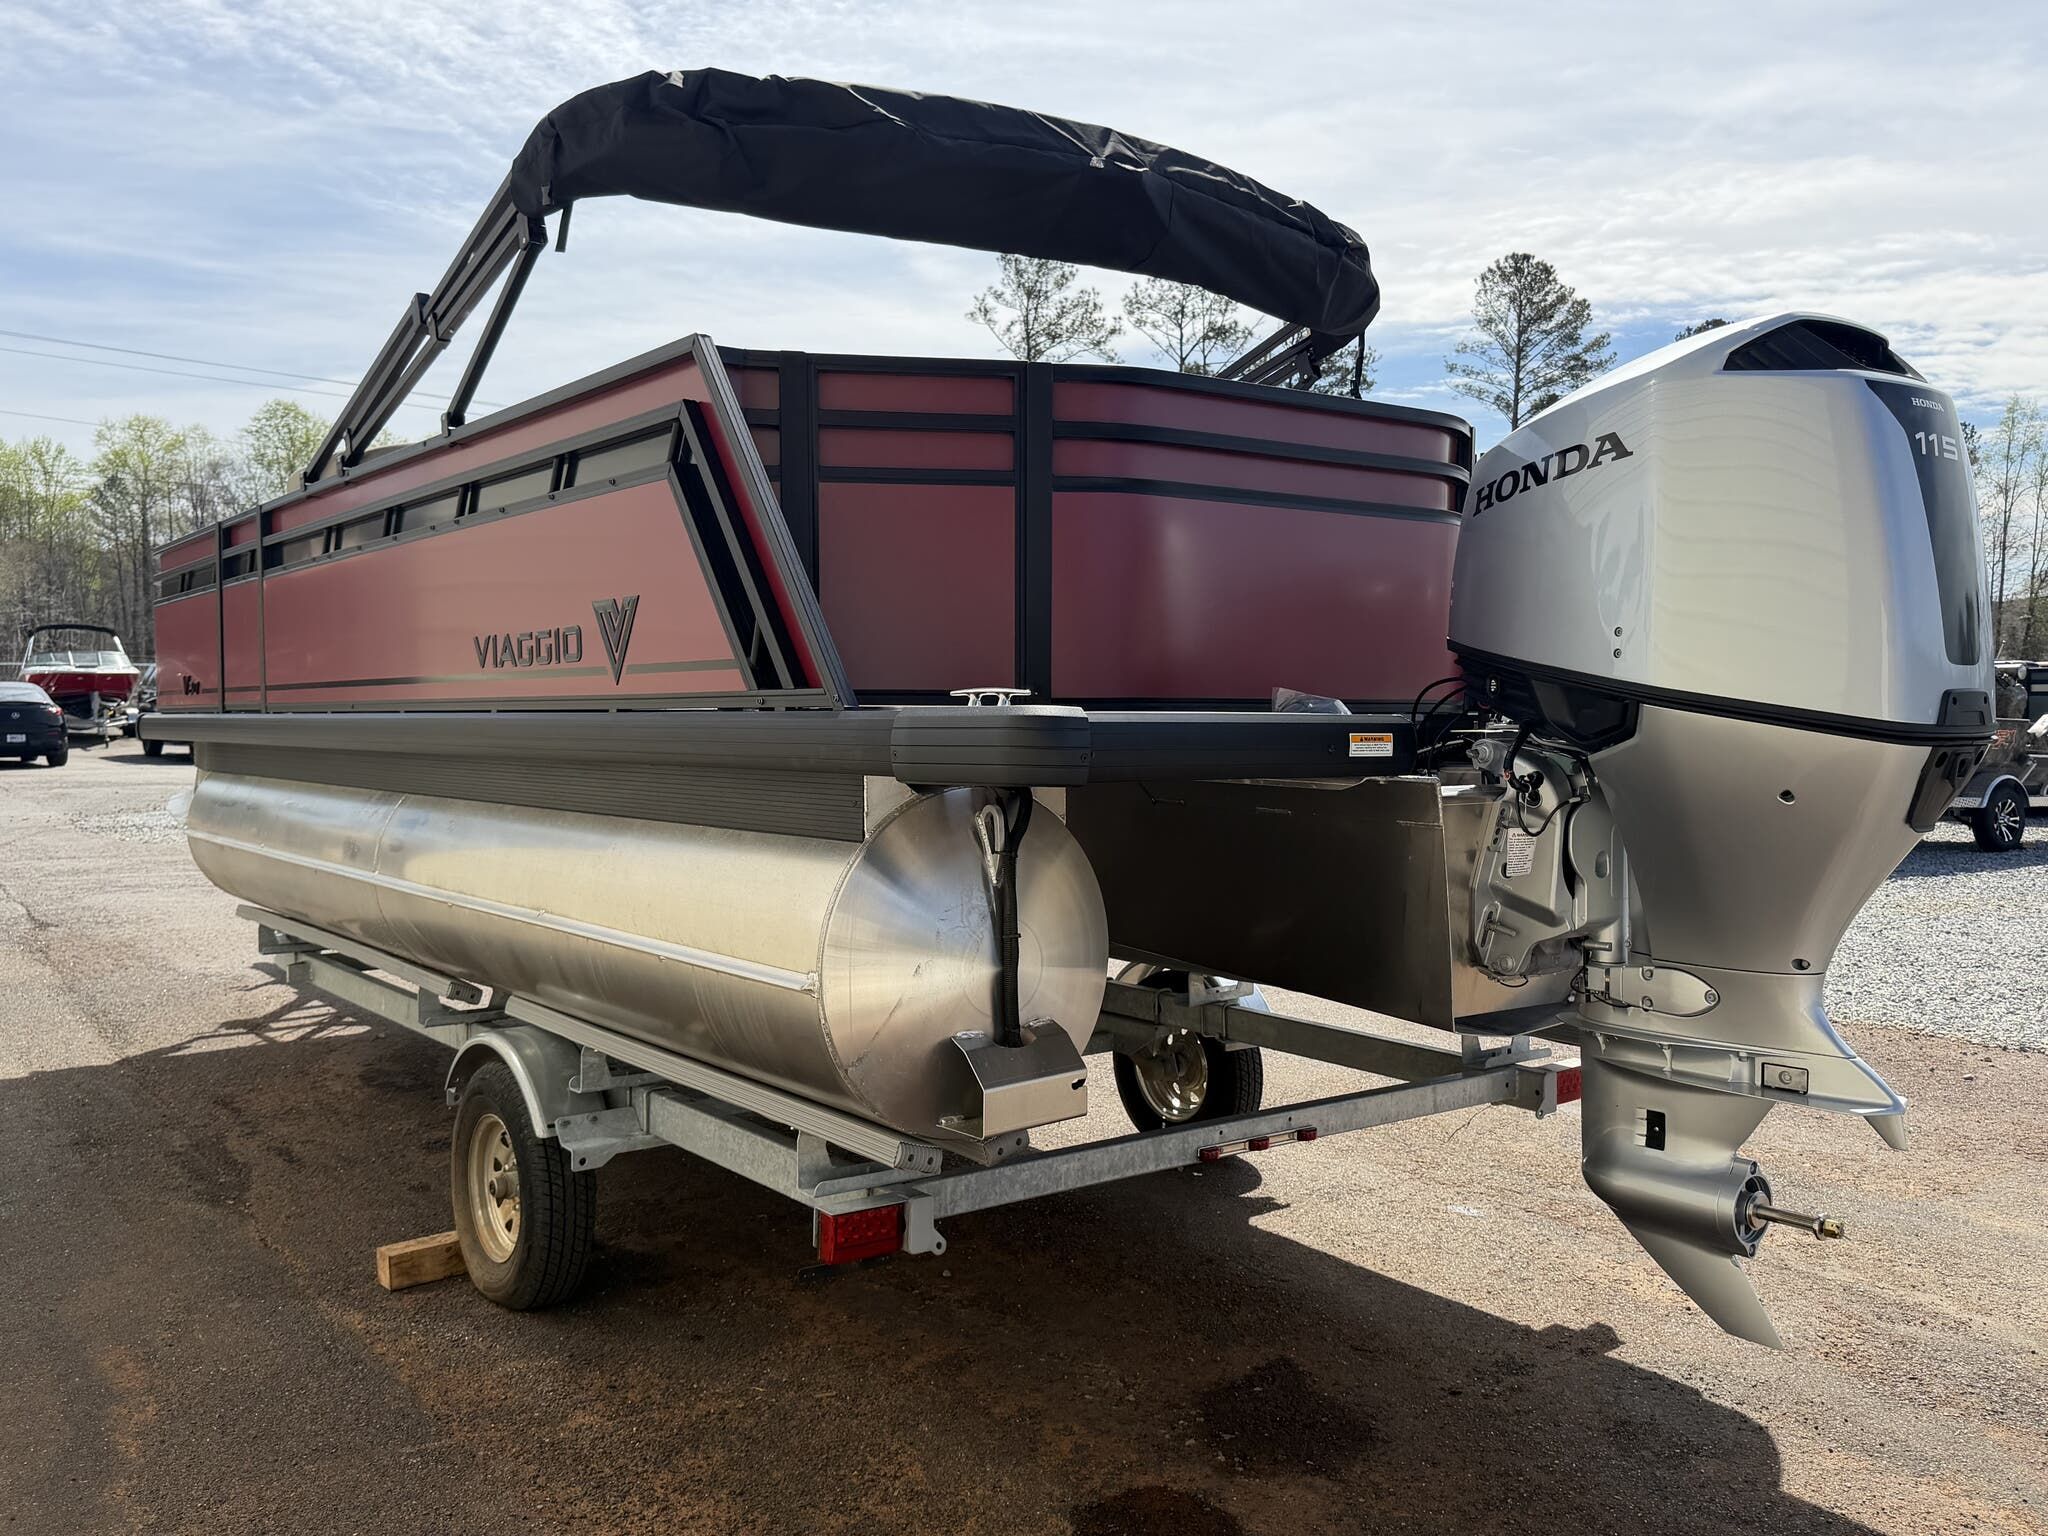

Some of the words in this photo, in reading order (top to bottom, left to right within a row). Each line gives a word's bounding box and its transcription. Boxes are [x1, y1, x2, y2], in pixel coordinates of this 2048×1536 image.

[1910, 397, 1945, 412] HONDA
[1914, 431, 1958, 461] 115
[1473, 431, 1633, 517] HONDA
[473, 624, 583, 669] VIAGGIO
